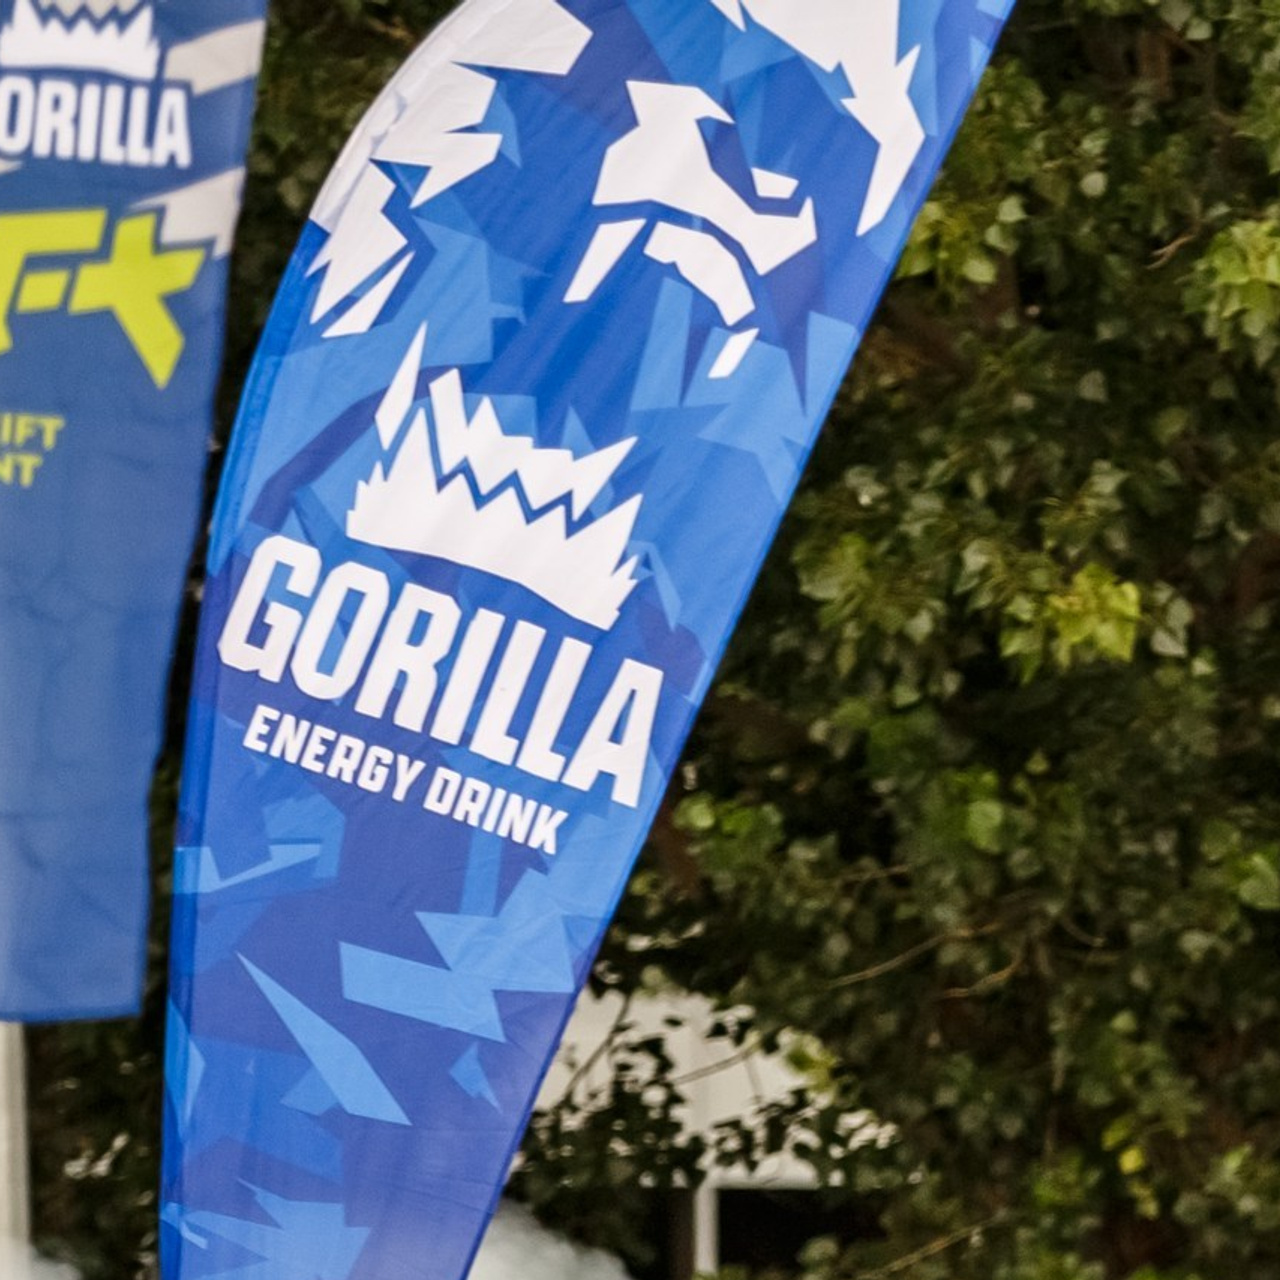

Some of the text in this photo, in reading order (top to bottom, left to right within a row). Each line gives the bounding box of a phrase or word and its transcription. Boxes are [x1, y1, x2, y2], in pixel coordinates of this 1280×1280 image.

[0, 75, 191, 168] ORILLA
[217, 535, 664, 808] GORILLA
[242, 704, 568, 855] ENERGY DRINK
